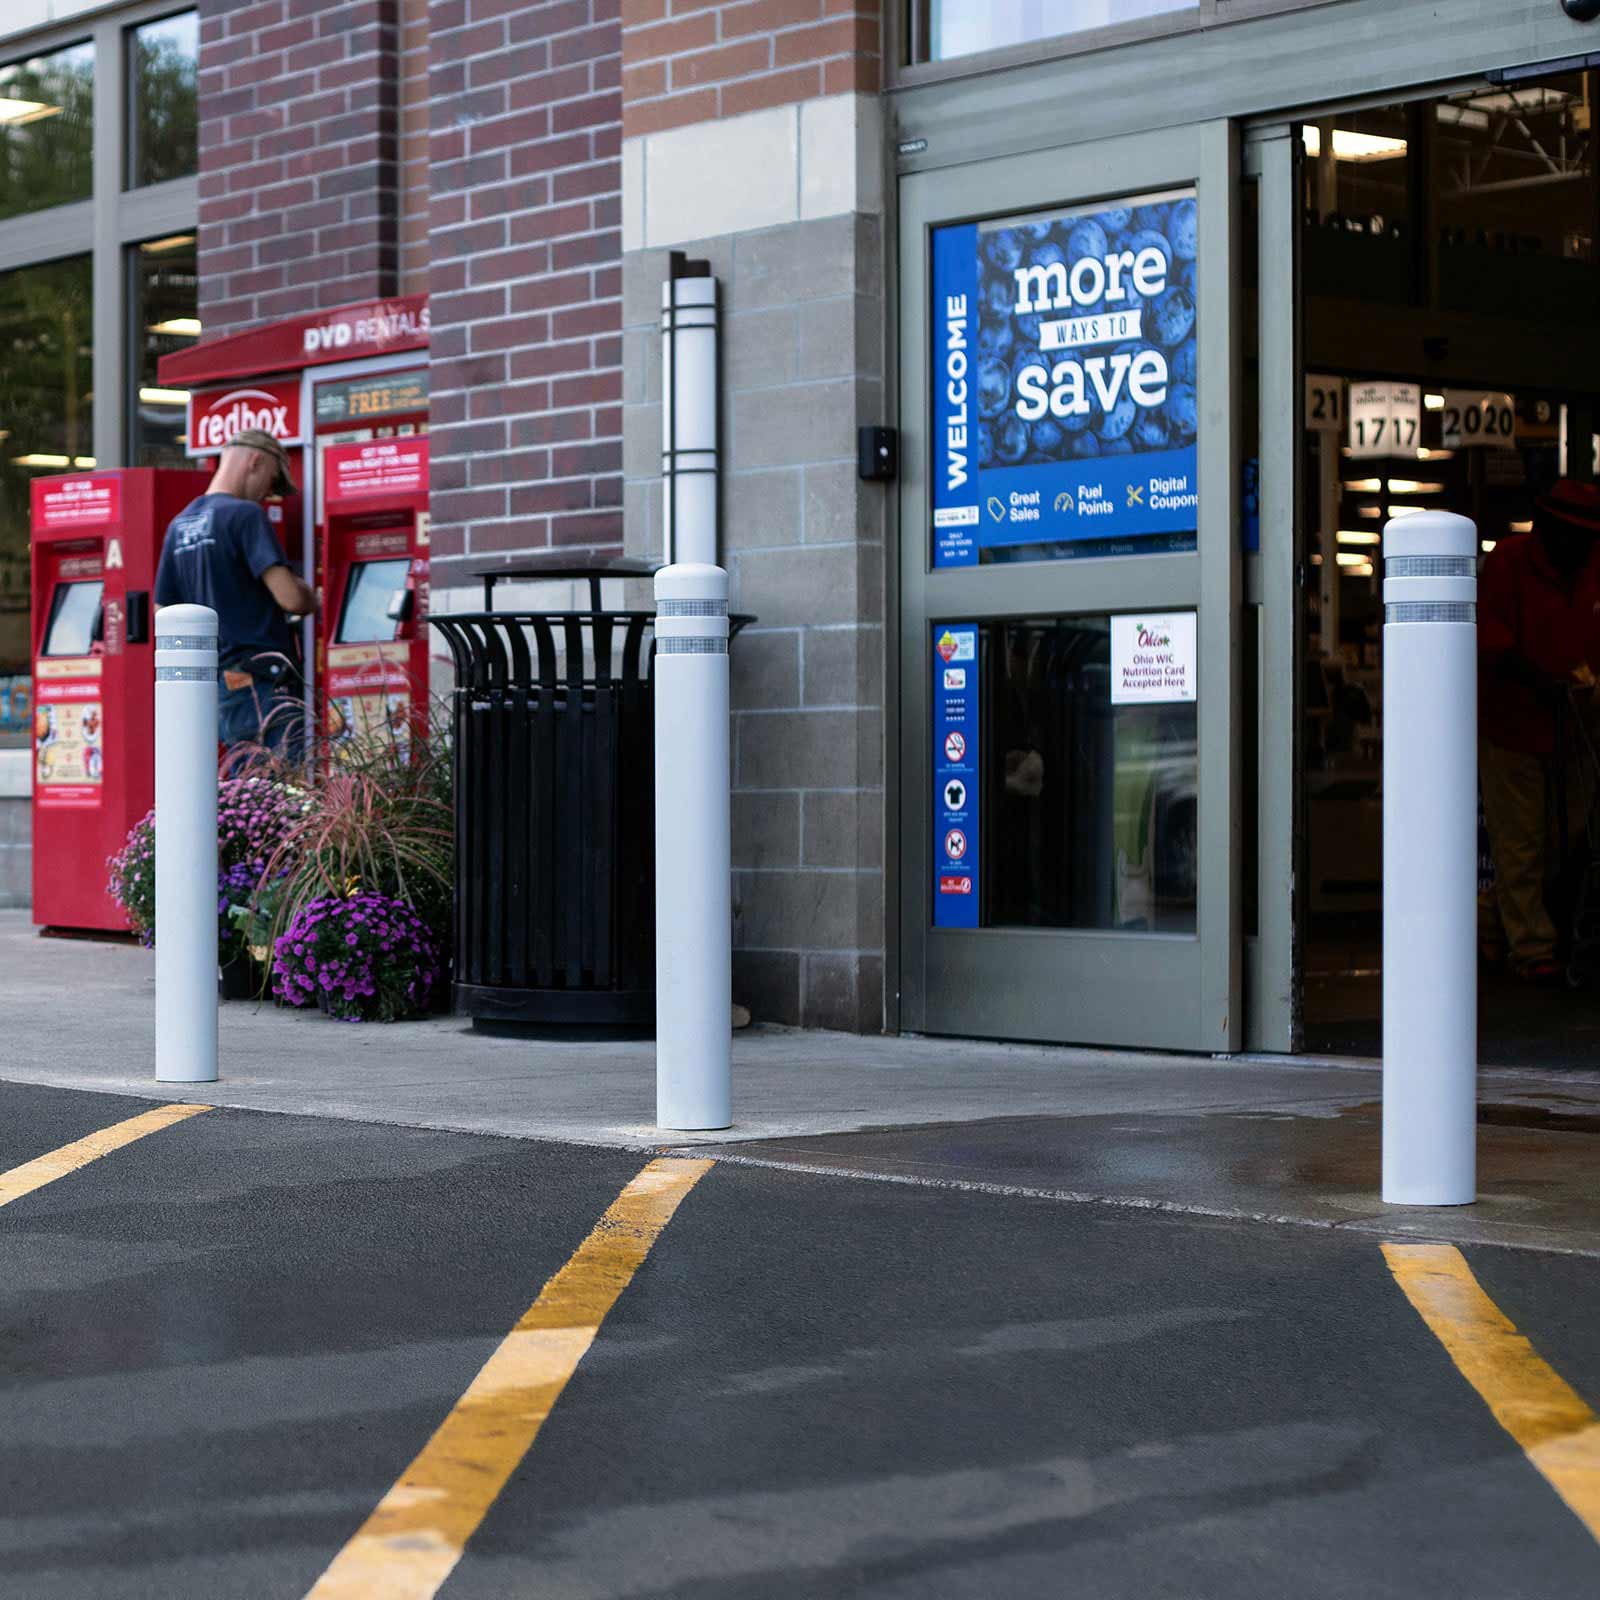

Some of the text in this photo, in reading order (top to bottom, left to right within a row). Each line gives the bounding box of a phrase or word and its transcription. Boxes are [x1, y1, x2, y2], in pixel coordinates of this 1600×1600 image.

[1014, 247, 1167, 315] more
[304, 307, 430, 352] DVD RENTALS
[1056, 317, 1128, 344] WAYS TO
[947, 294, 968, 490] WELCOME
[1015, 350, 1168, 421] save
[349, 388, 391, 415] FREE
[1312, 388, 1338, 419] 21
[198, 403, 288, 445] redbox
[1356, 417, 1386, 447] 17
[1393, 418, 1417, 446] 17
[1010, 491, 1040, 505] Great
[1078, 484, 1103, 500] Fuel
[1150, 476, 1188, 495] Digital
[1010, 507, 1040, 522] Sales
[1078, 500, 1114, 516] Points
[106, 539, 124, 568] A
[1122, 665, 1185, 677] Nutrition Card
[1133, 654, 1174, 664] Ohio WIC
[1122, 678, 1185, 688] Accepted Here
